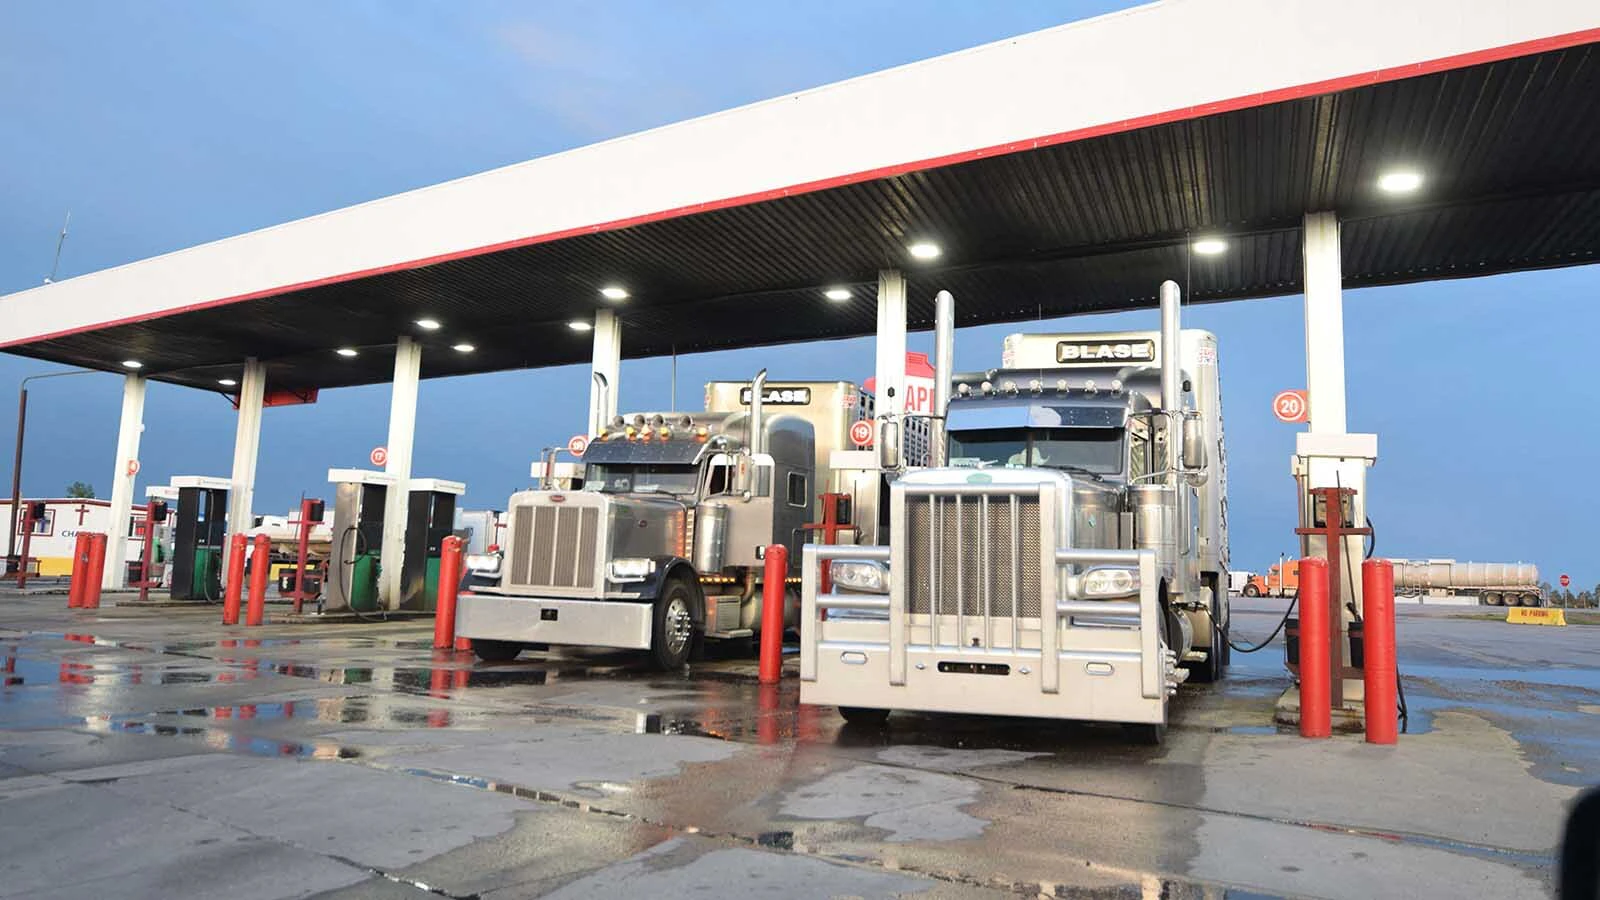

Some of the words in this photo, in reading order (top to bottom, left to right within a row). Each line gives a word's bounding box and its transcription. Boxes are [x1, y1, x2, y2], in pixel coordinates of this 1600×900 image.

[1061, 343, 1151, 359] BLASE
[1281, 399, 1298, 414] 20
[854, 426, 868, 439] 19
